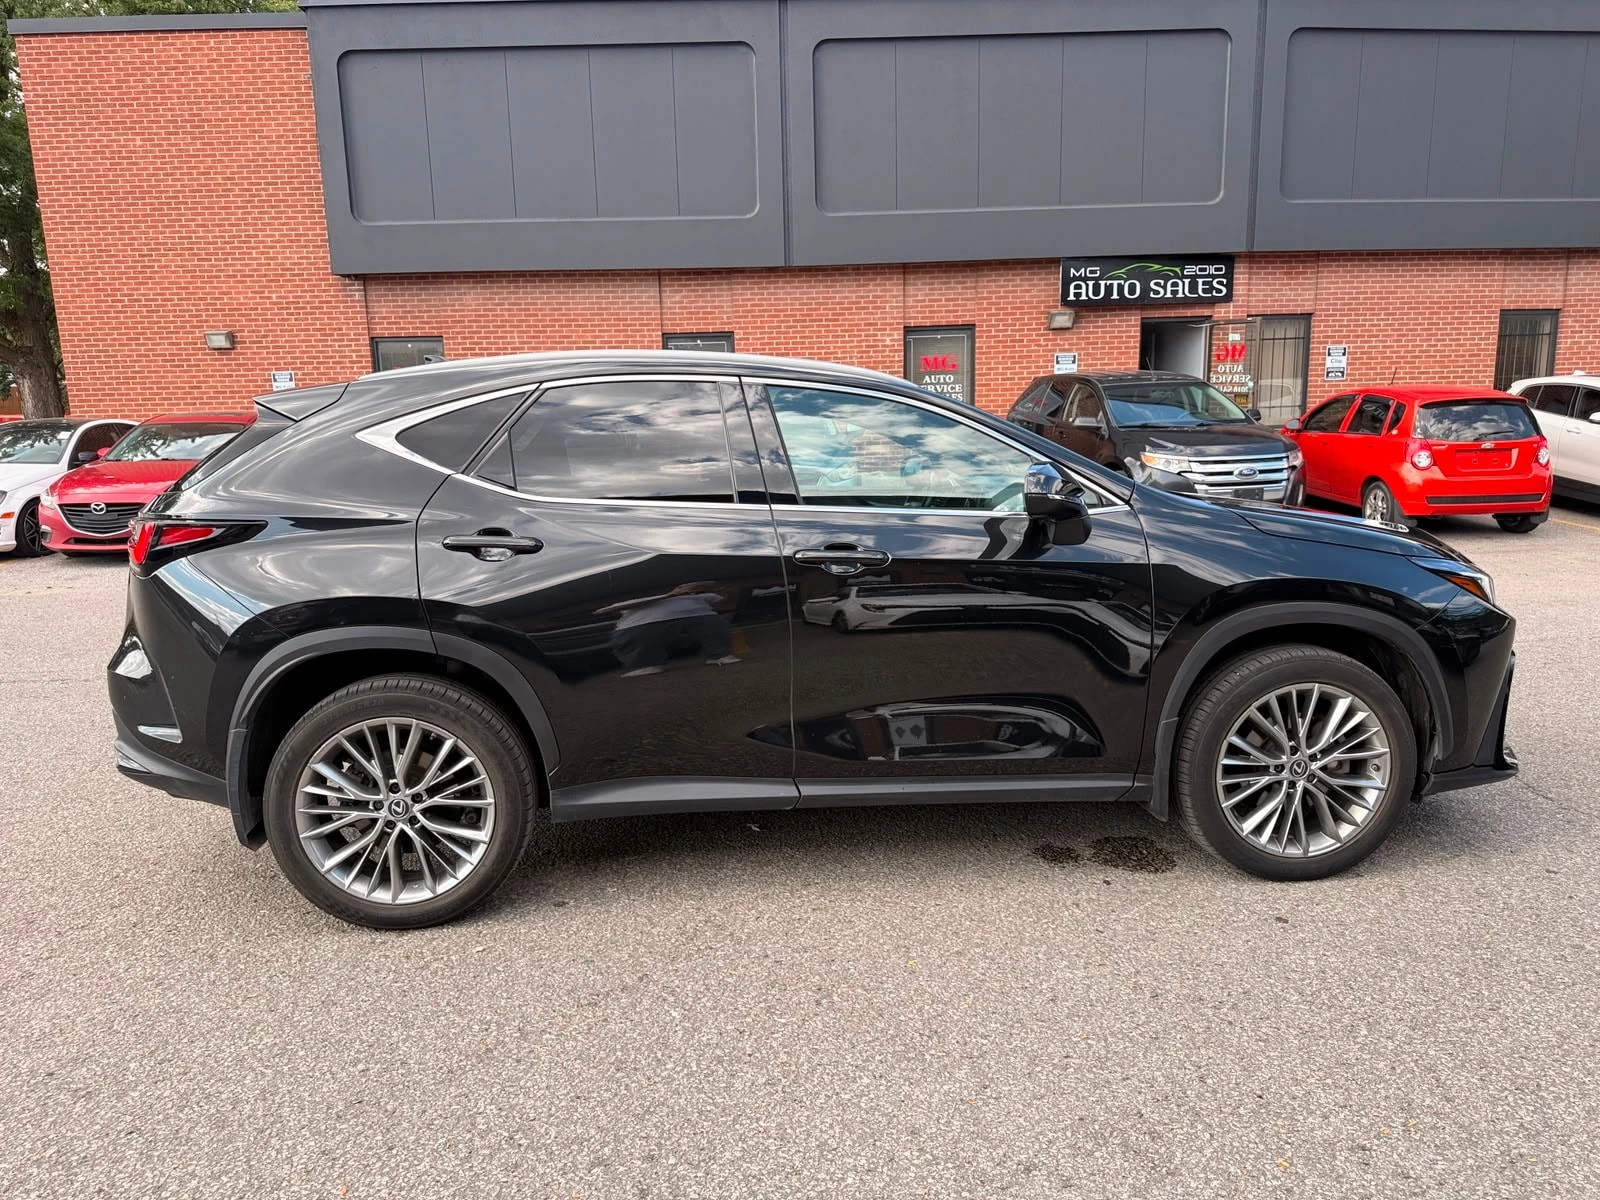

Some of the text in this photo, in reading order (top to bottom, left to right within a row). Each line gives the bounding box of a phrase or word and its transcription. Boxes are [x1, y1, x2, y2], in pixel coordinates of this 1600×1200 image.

[1070, 265, 1226, 278] MG 2010
[1067, 278, 1227, 300] AUTO SALES
[920, 355, 957, 372] MG
[923, 374, 954, 384] AUTO
